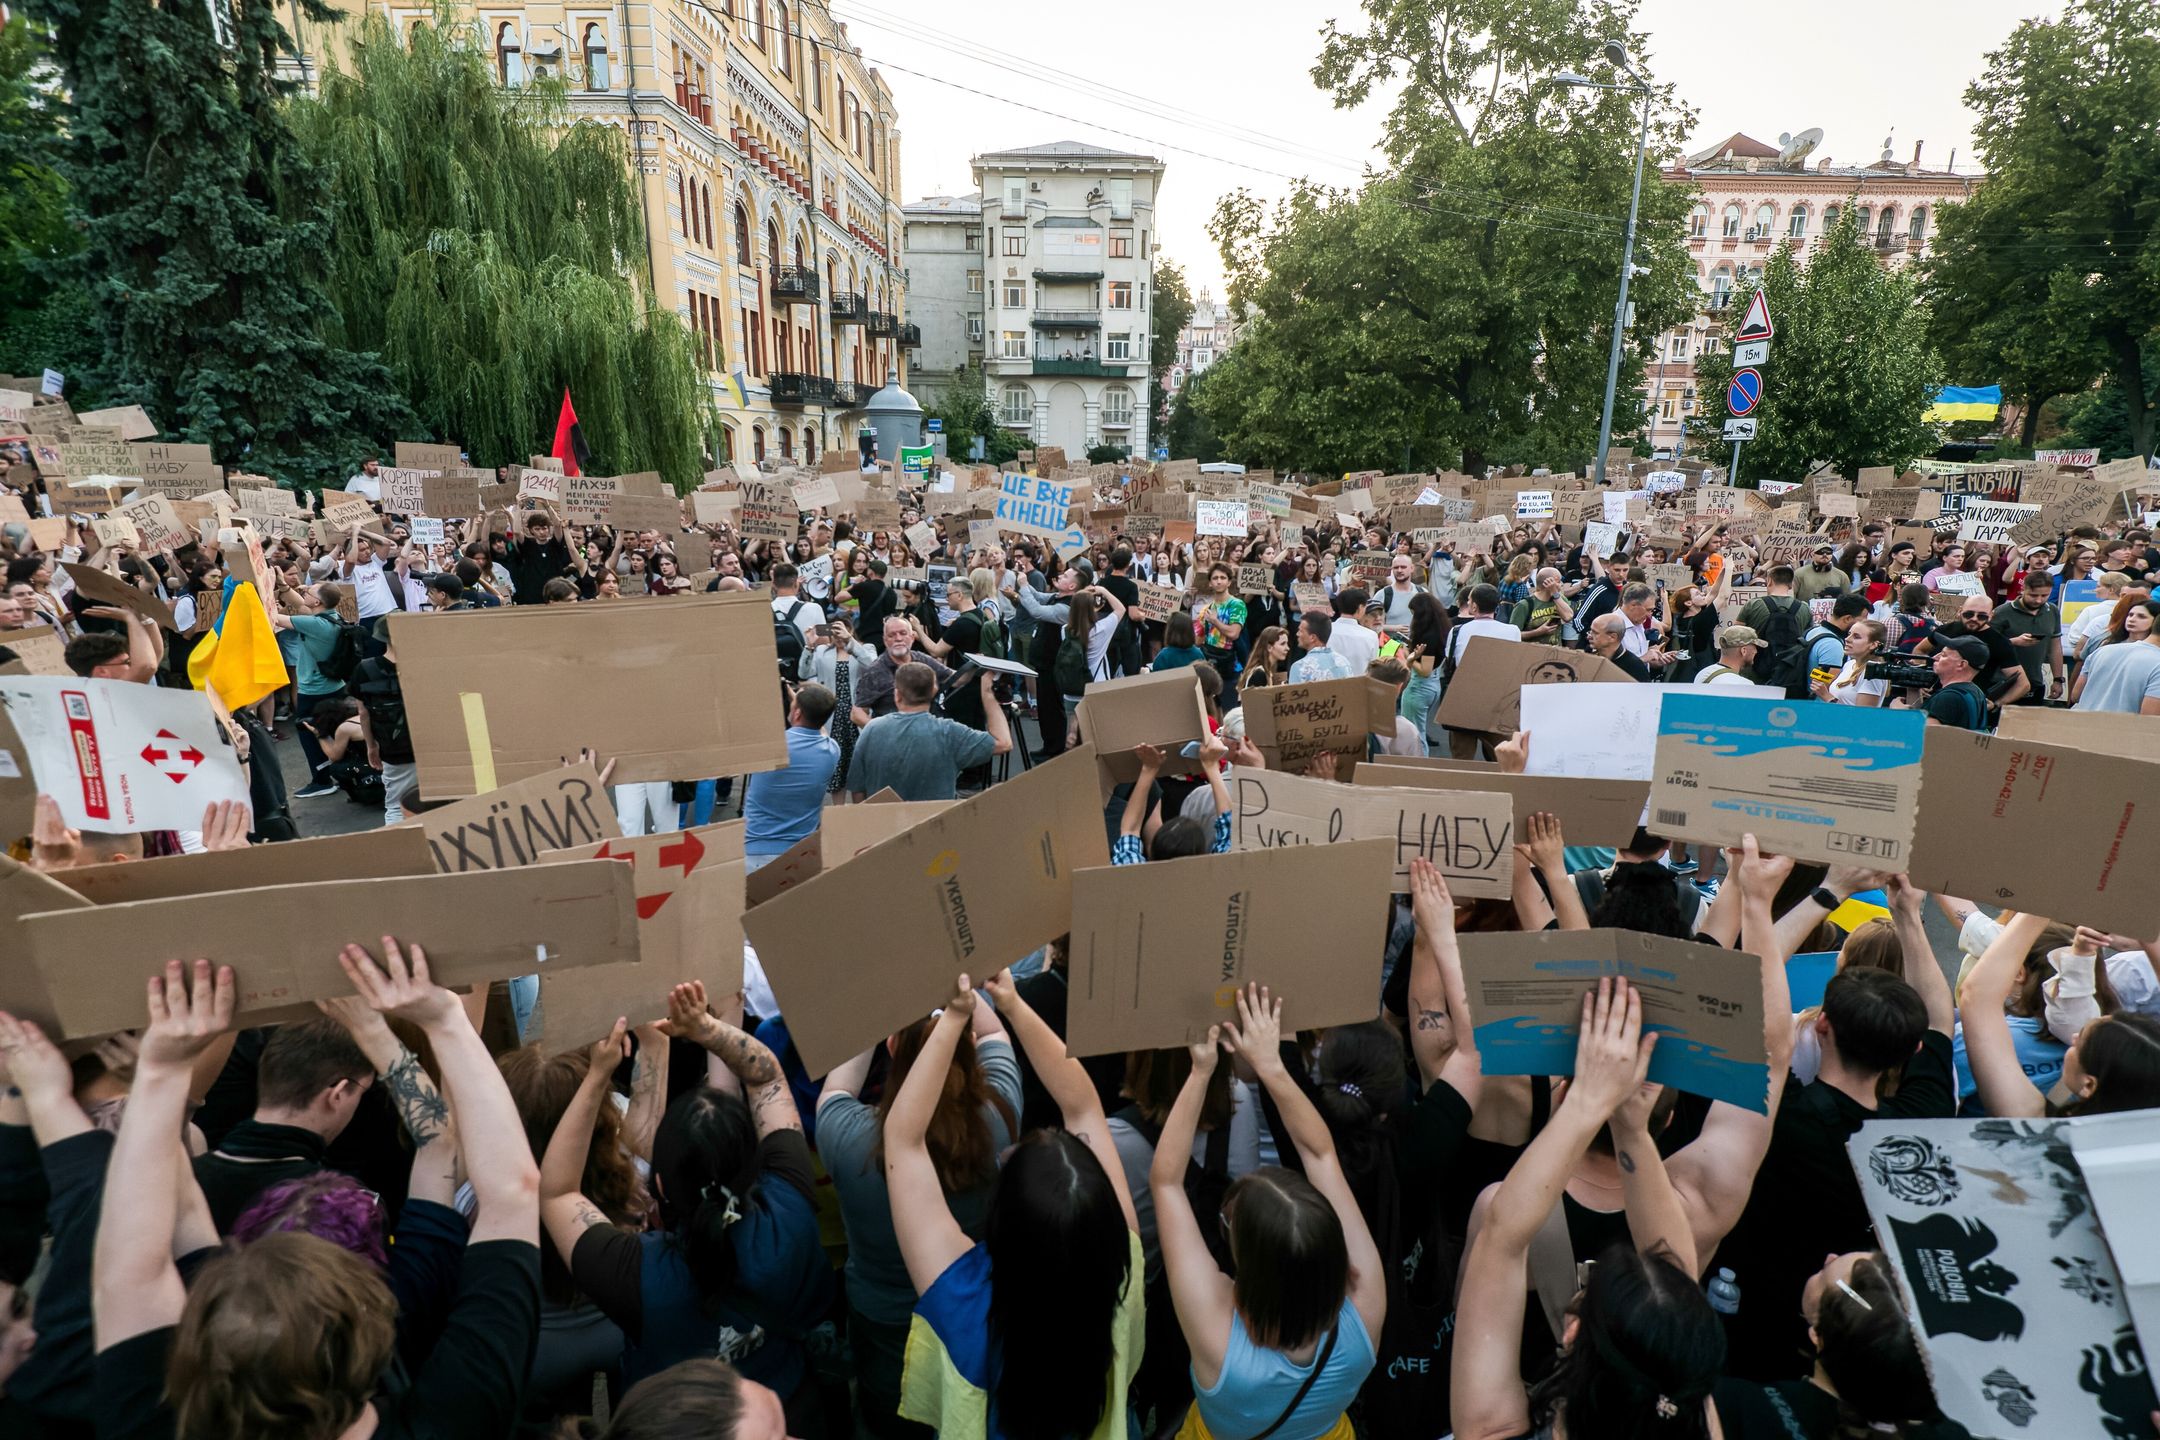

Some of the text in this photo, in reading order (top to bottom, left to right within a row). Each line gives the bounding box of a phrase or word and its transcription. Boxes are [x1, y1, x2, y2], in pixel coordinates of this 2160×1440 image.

[146, 463, 189, 474] НАБУ
[570, 479, 616, 490] НАХУЯ
[1122, 473, 1160, 499] ВОВА
[1944, 470, 2020, 494] НЕ МОВЧИ!
[1003, 474, 1031, 498] ЦЕ
[1036, 480, 1073, 508] ВЖЕ
[1561, 493, 1580, 503] ВСЕ
[1707, 490, 1735, 498] ІДЕМ
[1124, 493, 1142, 512] ТИ
[1940, 494, 1959, 511] ЦЕ
[123, 500, 160, 524] ВЕТО
[743, 510, 771, 519] НАБУ
[996, 497, 1068, 532] КІНЕЦЬ
[1966, 506, 1978, 519] ТИ
[143, 518, 158, 530] НА
[1776, 519, 1805, 532] ГАНЬБА
[144, 525, 170, 544] АКОН
[1055, 531, 1084, 553] ?
[1764, 535, 1829, 547] МОГИЛЯНКА
[1241, 575, 1255, 584] ЦЕ
[1242, 568, 1266, 576] ВОВА
[1144, 596, 1174, 609] СИСТЕМА
[1164, 593, 1181, 602] МЕНІ
[2034, 754, 2048, 768] 30
[1682, 780, 1698, 788] 950
[120, 773, 136, 825] НОВА ПОШТА
[1398, 809, 1511, 870] НАБУ
[944, 874, 976, 959] УКРПОШТА
[1222, 891, 1241, 983] УКРПОШТА
[1935, 1249, 1971, 1303] РОДОВІД
[1387, 1355, 1431, 1380] CAFE
